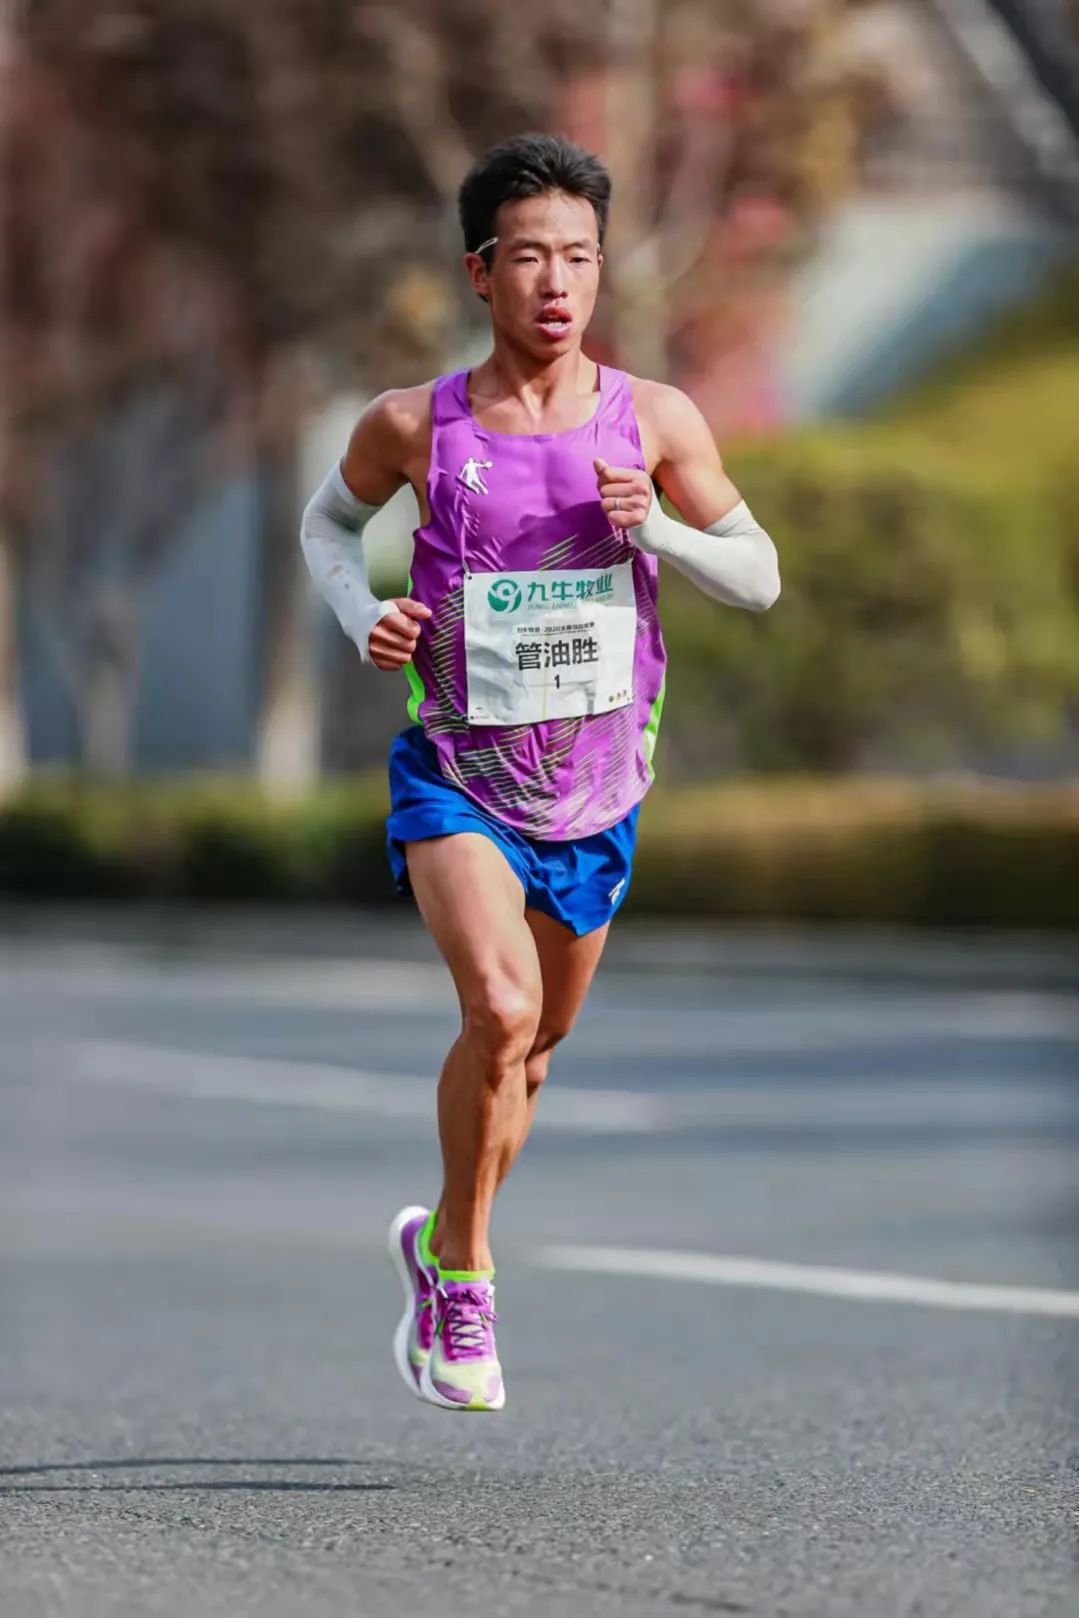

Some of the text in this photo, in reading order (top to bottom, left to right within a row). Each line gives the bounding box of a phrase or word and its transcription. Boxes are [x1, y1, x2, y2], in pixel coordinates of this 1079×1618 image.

[527, 573, 613, 601] 九牛牧业
[515, 636, 598, 671] 管油胜
[554, 674, 560, 689] 1
